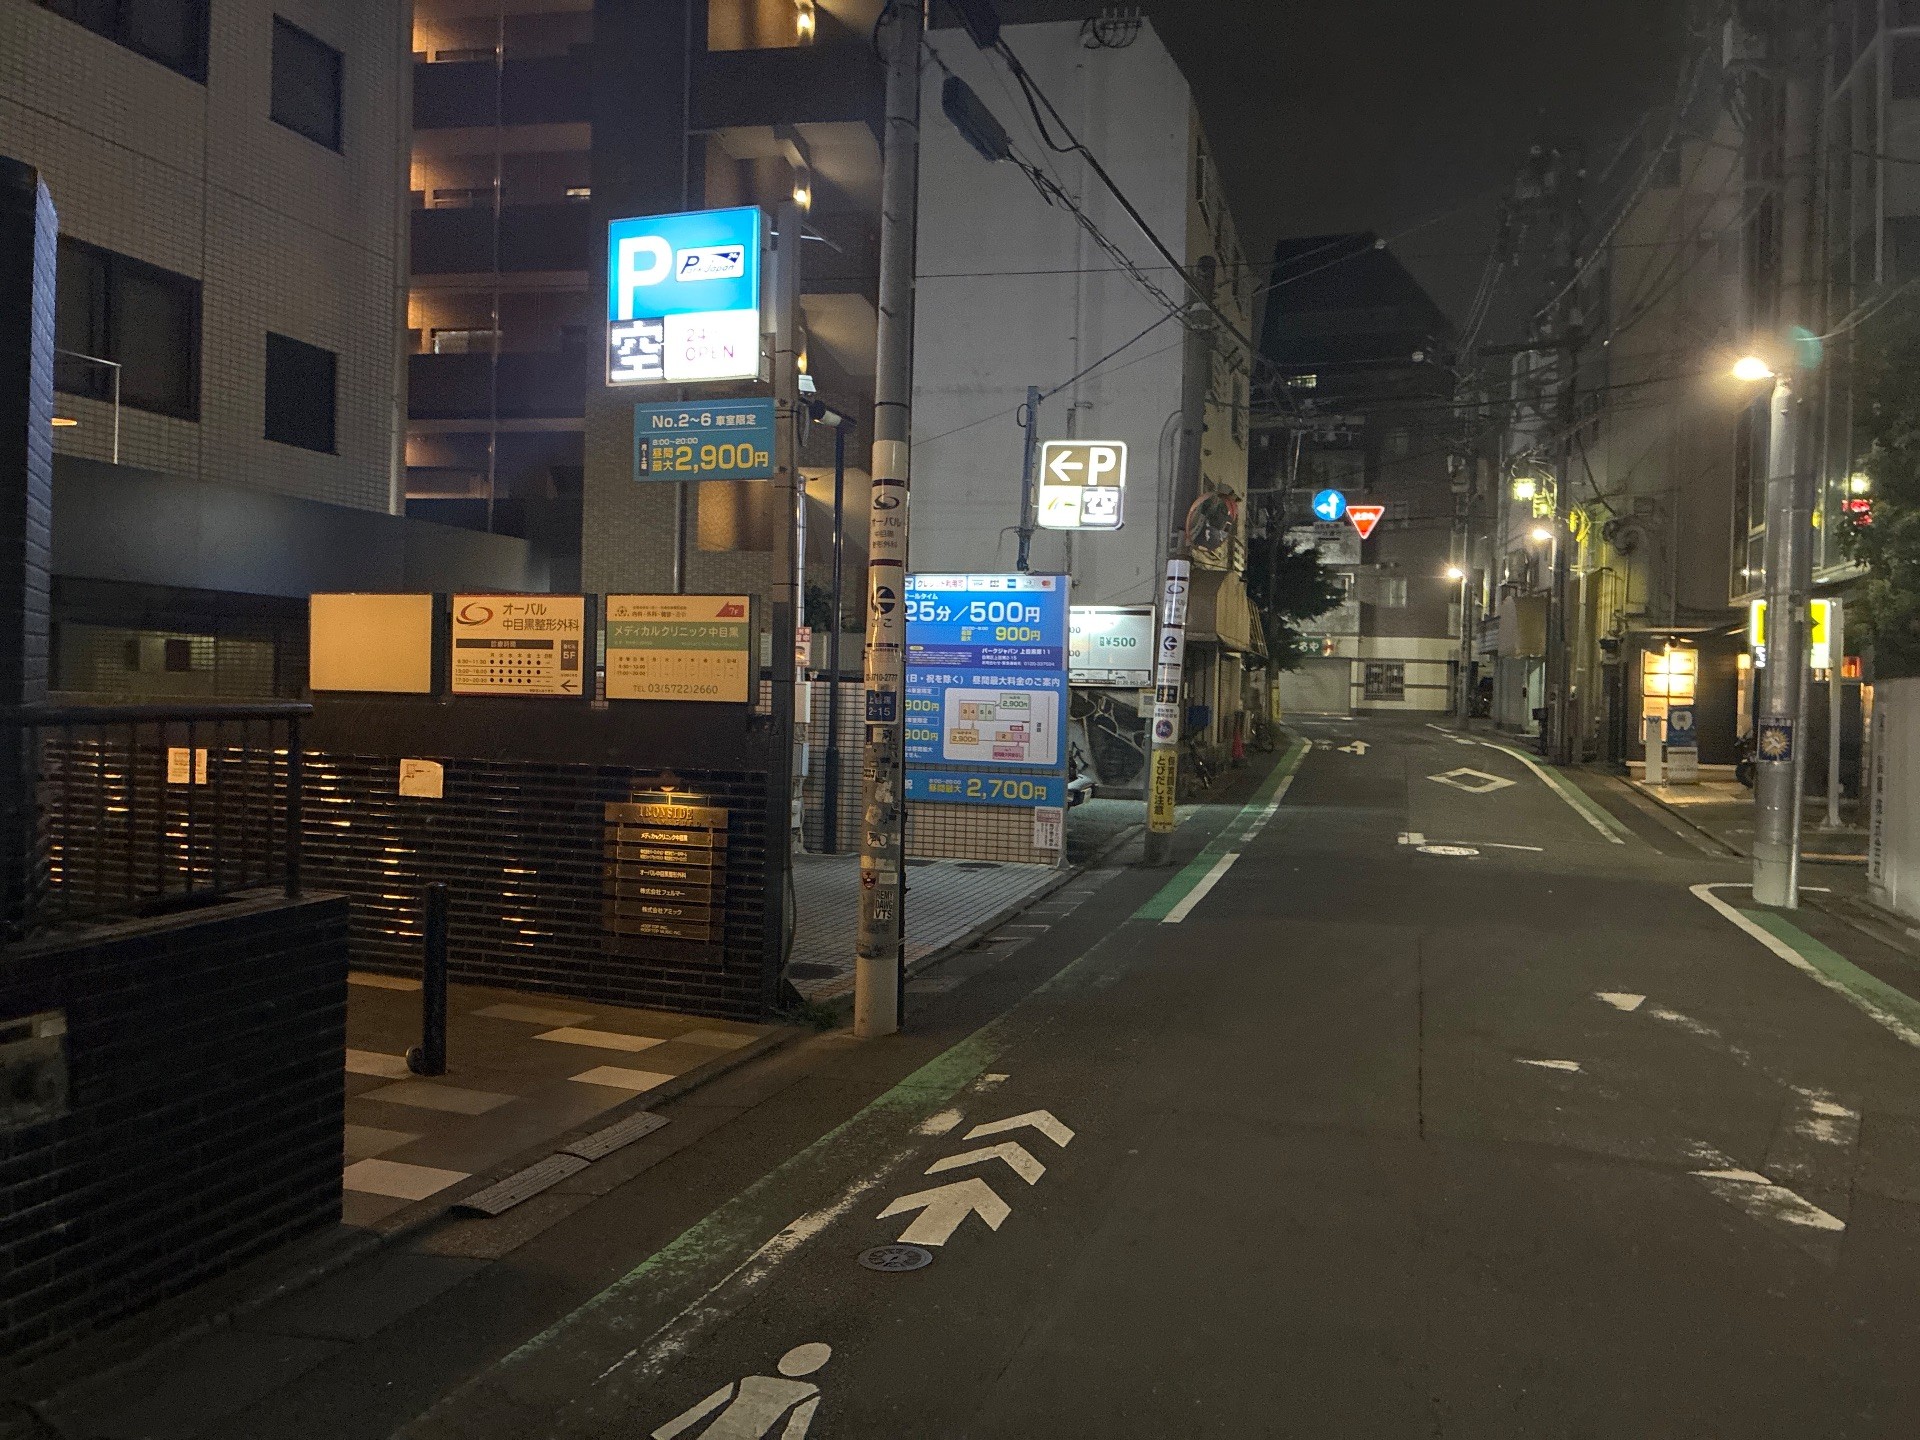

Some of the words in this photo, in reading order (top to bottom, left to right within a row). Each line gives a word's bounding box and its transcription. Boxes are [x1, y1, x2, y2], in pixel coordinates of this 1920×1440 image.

[618, 235, 673, 320] P
[611, 320, 663, 380] 空
[685, 345, 734, 361] OPEN
[675, 443, 769, 474] 2,900円
[1088, 447, 1117, 486] P
[503, 602, 547, 616] オーバル
[502, 618, 580, 632] 中目黒整形外科
[614, 626, 739, 638] メディカルクリニック中目黒
[995, 626, 1041, 642] 900円
[1105, 637, 1137, 647] ¥500
[972, 675, 1061, 688] 昼間最大料金のご案内
[648, 683, 719, 695] 03(5722)2660
[868, 707, 891, 716] 2-15
[966, 778, 1047, 801] 2,700円
[639, 806, 694, 820] IRONSIDE
[639, 887, 687, 897] 株式会社フェルマー
[641, 906, 683, 916] 株式会社アミック
